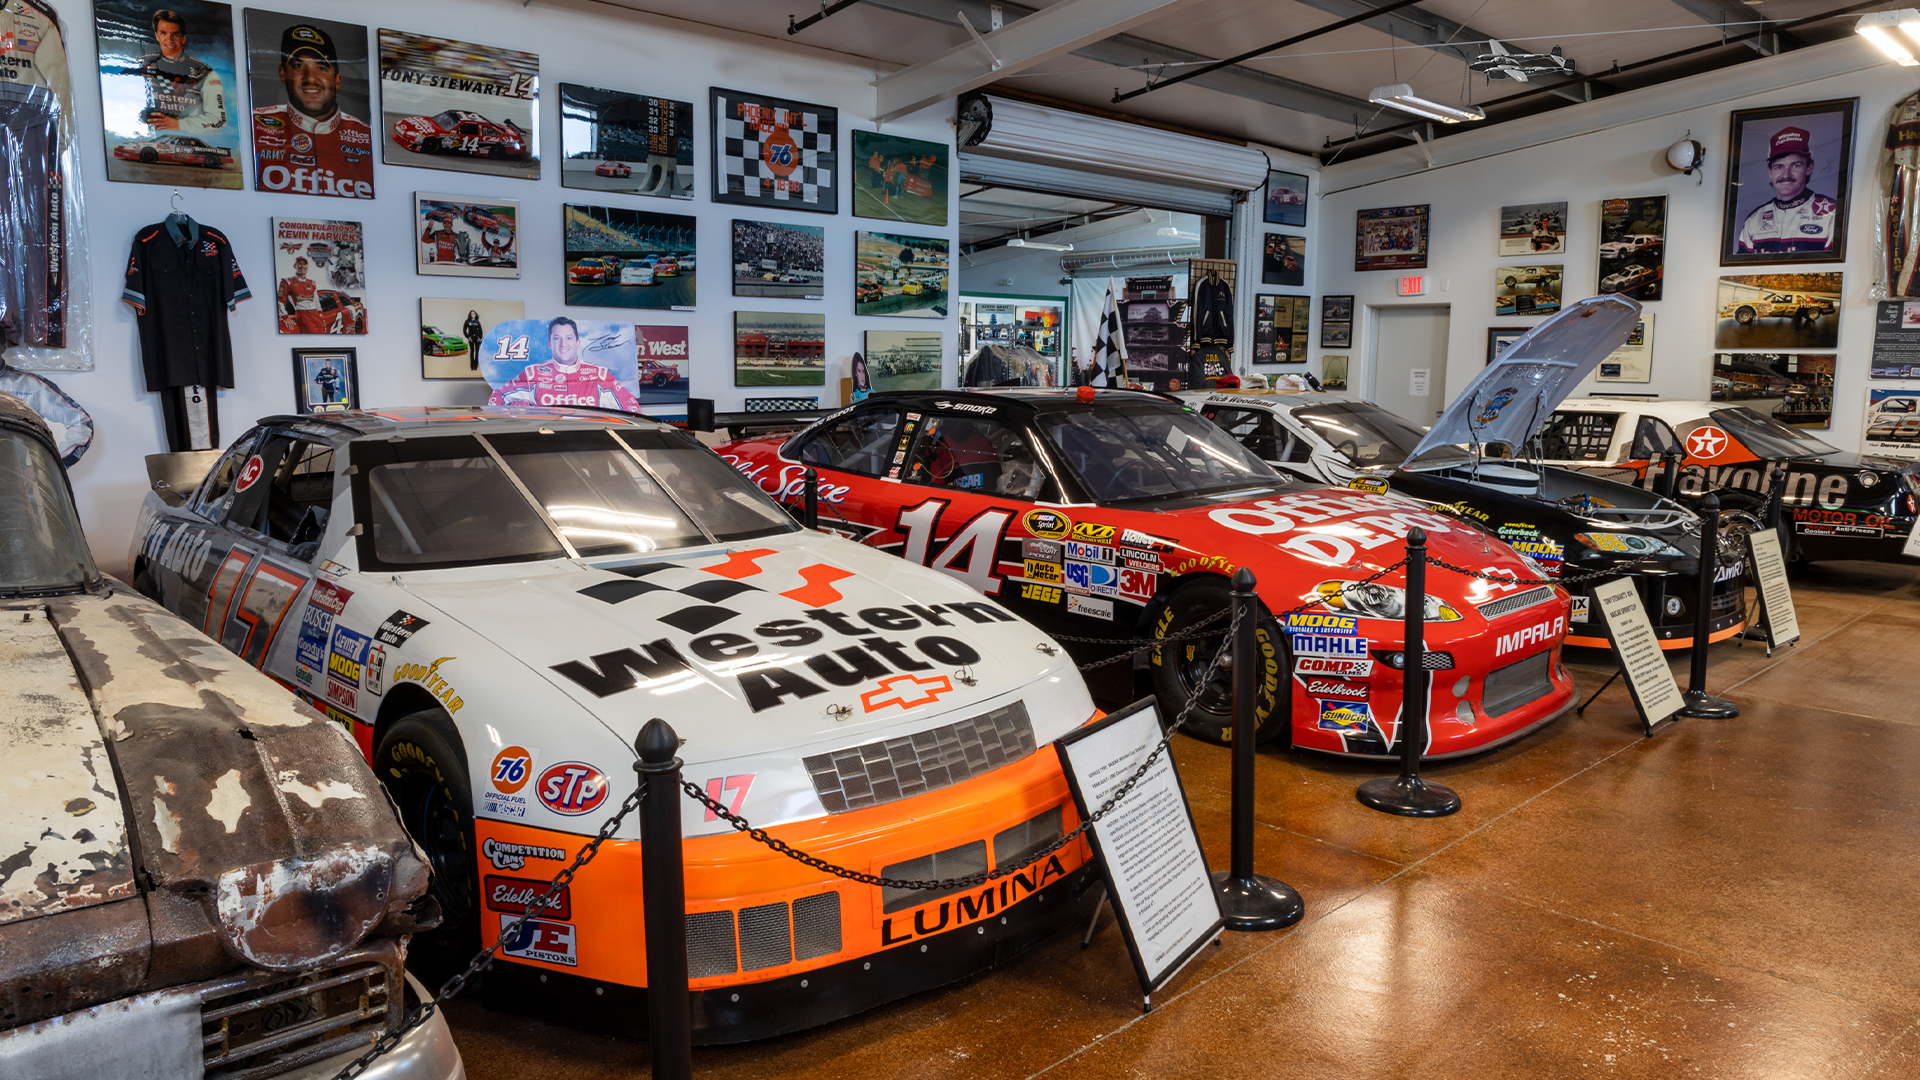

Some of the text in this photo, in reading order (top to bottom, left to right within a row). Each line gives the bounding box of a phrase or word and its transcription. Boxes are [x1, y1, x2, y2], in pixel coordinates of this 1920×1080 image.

[381, 68, 538, 99] TONY STEWART 14
[160, 101, 185, 111] Auto
[648, 98, 659, 107] 30
[456, 111, 485, 122] 14
[648, 107, 659, 117] 31
[648, 116, 659, 126] 32
[737, 102, 808, 127] PHOENIX INT'L
[339, 129, 370, 138] Office
[648, 125, 659, 136] 33
[749, 118, 791, 135] RACEWAY
[1899, 129, 1920, 141] Hav
[340, 135, 371, 144] DEPOT
[458, 136, 480, 152] 14
[1777, 132, 1801, 141] Winston
[260, 149, 286, 160] ARMY
[769, 143, 794, 167] 76
[262, 165, 373, 199] Office
[49, 190, 60, 274] Western Auto
[278, 229, 360, 242] KEVIN HARVICK!
[279, 221, 356, 233] CONGRATULATIONS,
[1802, 225, 1820, 233] Ford
[1889, 205, 1902, 272] Havoline
[1402, 276, 1423, 294] EXIT
[1771, 304, 1800, 316] 28
[330, 311, 344, 335] 4
[493, 334, 530, 360] 14
[649, 340, 687, 356] West
[540, 393, 597, 408] Office
[1205, 394, 1276, 408] Rich Woodland
[826, 404, 856, 422] DEPOT
[241, 465, 258, 481] AC
[757, 465, 850, 505] Spice
[1355, 484, 1380, 493] NEXTEL
[1208, 493, 1422, 535] Office
[1429, 501, 1490, 522] OODYEAR
[1793, 508, 1896, 530] MOTOR OIL
[1037, 521, 1056, 529] Sprint
[1498, 526, 1540, 537] Gatorback
[1835, 526, 1876, 534] Anti-Freeze
[1095, 537, 1112, 545] WEAR
[1121, 529, 1155, 549] Holley
[1279, 507, 1477, 565] DEPOT
[1589, 533, 1629, 551] 86
[160, 522, 212, 582] Auto
[896, 497, 1016, 599] 14
[1028, 552, 1053, 560] POLE
[1040, 546, 1058, 555] LIGHT
[1067, 542, 1099, 559] Mobil
[1122, 549, 1157, 562] LINCOLN
[1511, 541, 1564, 555] MOOG
[1034, 562, 1055, 571] Auto
[1129, 559, 1160, 571] WELDERS
[1170, 556, 1235, 578] GOODYE
[1714, 560, 1744, 583] AMRY
[1033, 569, 1059, 581] Meter
[1066, 562, 1089, 588] USG
[1120, 569, 1156, 598] 3M
[311, 589, 332, 608] Winston
[1022, 584, 1062, 604] JEGS
[1090, 585, 1118, 595] DIRECTV
[203, 543, 314, 672] 17
[1077, 604, 1112, 618] freescale
[303, 605, 334, 634] BUSCH
[1287, 614, 1357, 629] MOOG
[380, 631, 398, 644] Auto
[381, 620, 413, 639] Western
[1152, 606, 1175, 667] EAGLE
[1496, 616, 1564, 657] IMPALA
[298, 637, 325, 660] Goody's
[549, 600, 1019, 699] Western
[1294, 636, 1367, 654] MAHLE
[329, 652, 361, 682] MOOG
[1299, 659, 1354, 671] COMP
[295, 665, 313, 684] Gatorade
[734, 635, 981, 714] Auto
[326, 680, 356, 709] SIMPSON
[393, 662, 464, 715] GOODYEAR
[1308, 681, 1367, 698] Edelbrock
[1323, 711, 1365, 722] SUNOCO
[493, 756, 530, 784] 76
[543, 768, 600, 808] STP
[704, 772, 758, 822] 17
[485, 791, 526, 804] OFFICIAL FUEL
[482, 837, 566, 861] COMPETITION
[493, 852, 526, 872] CAMS
[492, 884, 563, 910] Edelbk
[881, 854, 1067, 947] LUMINA
[502, 920, 571, 954] JE
[524, 949, 576, 965] PISTONS
